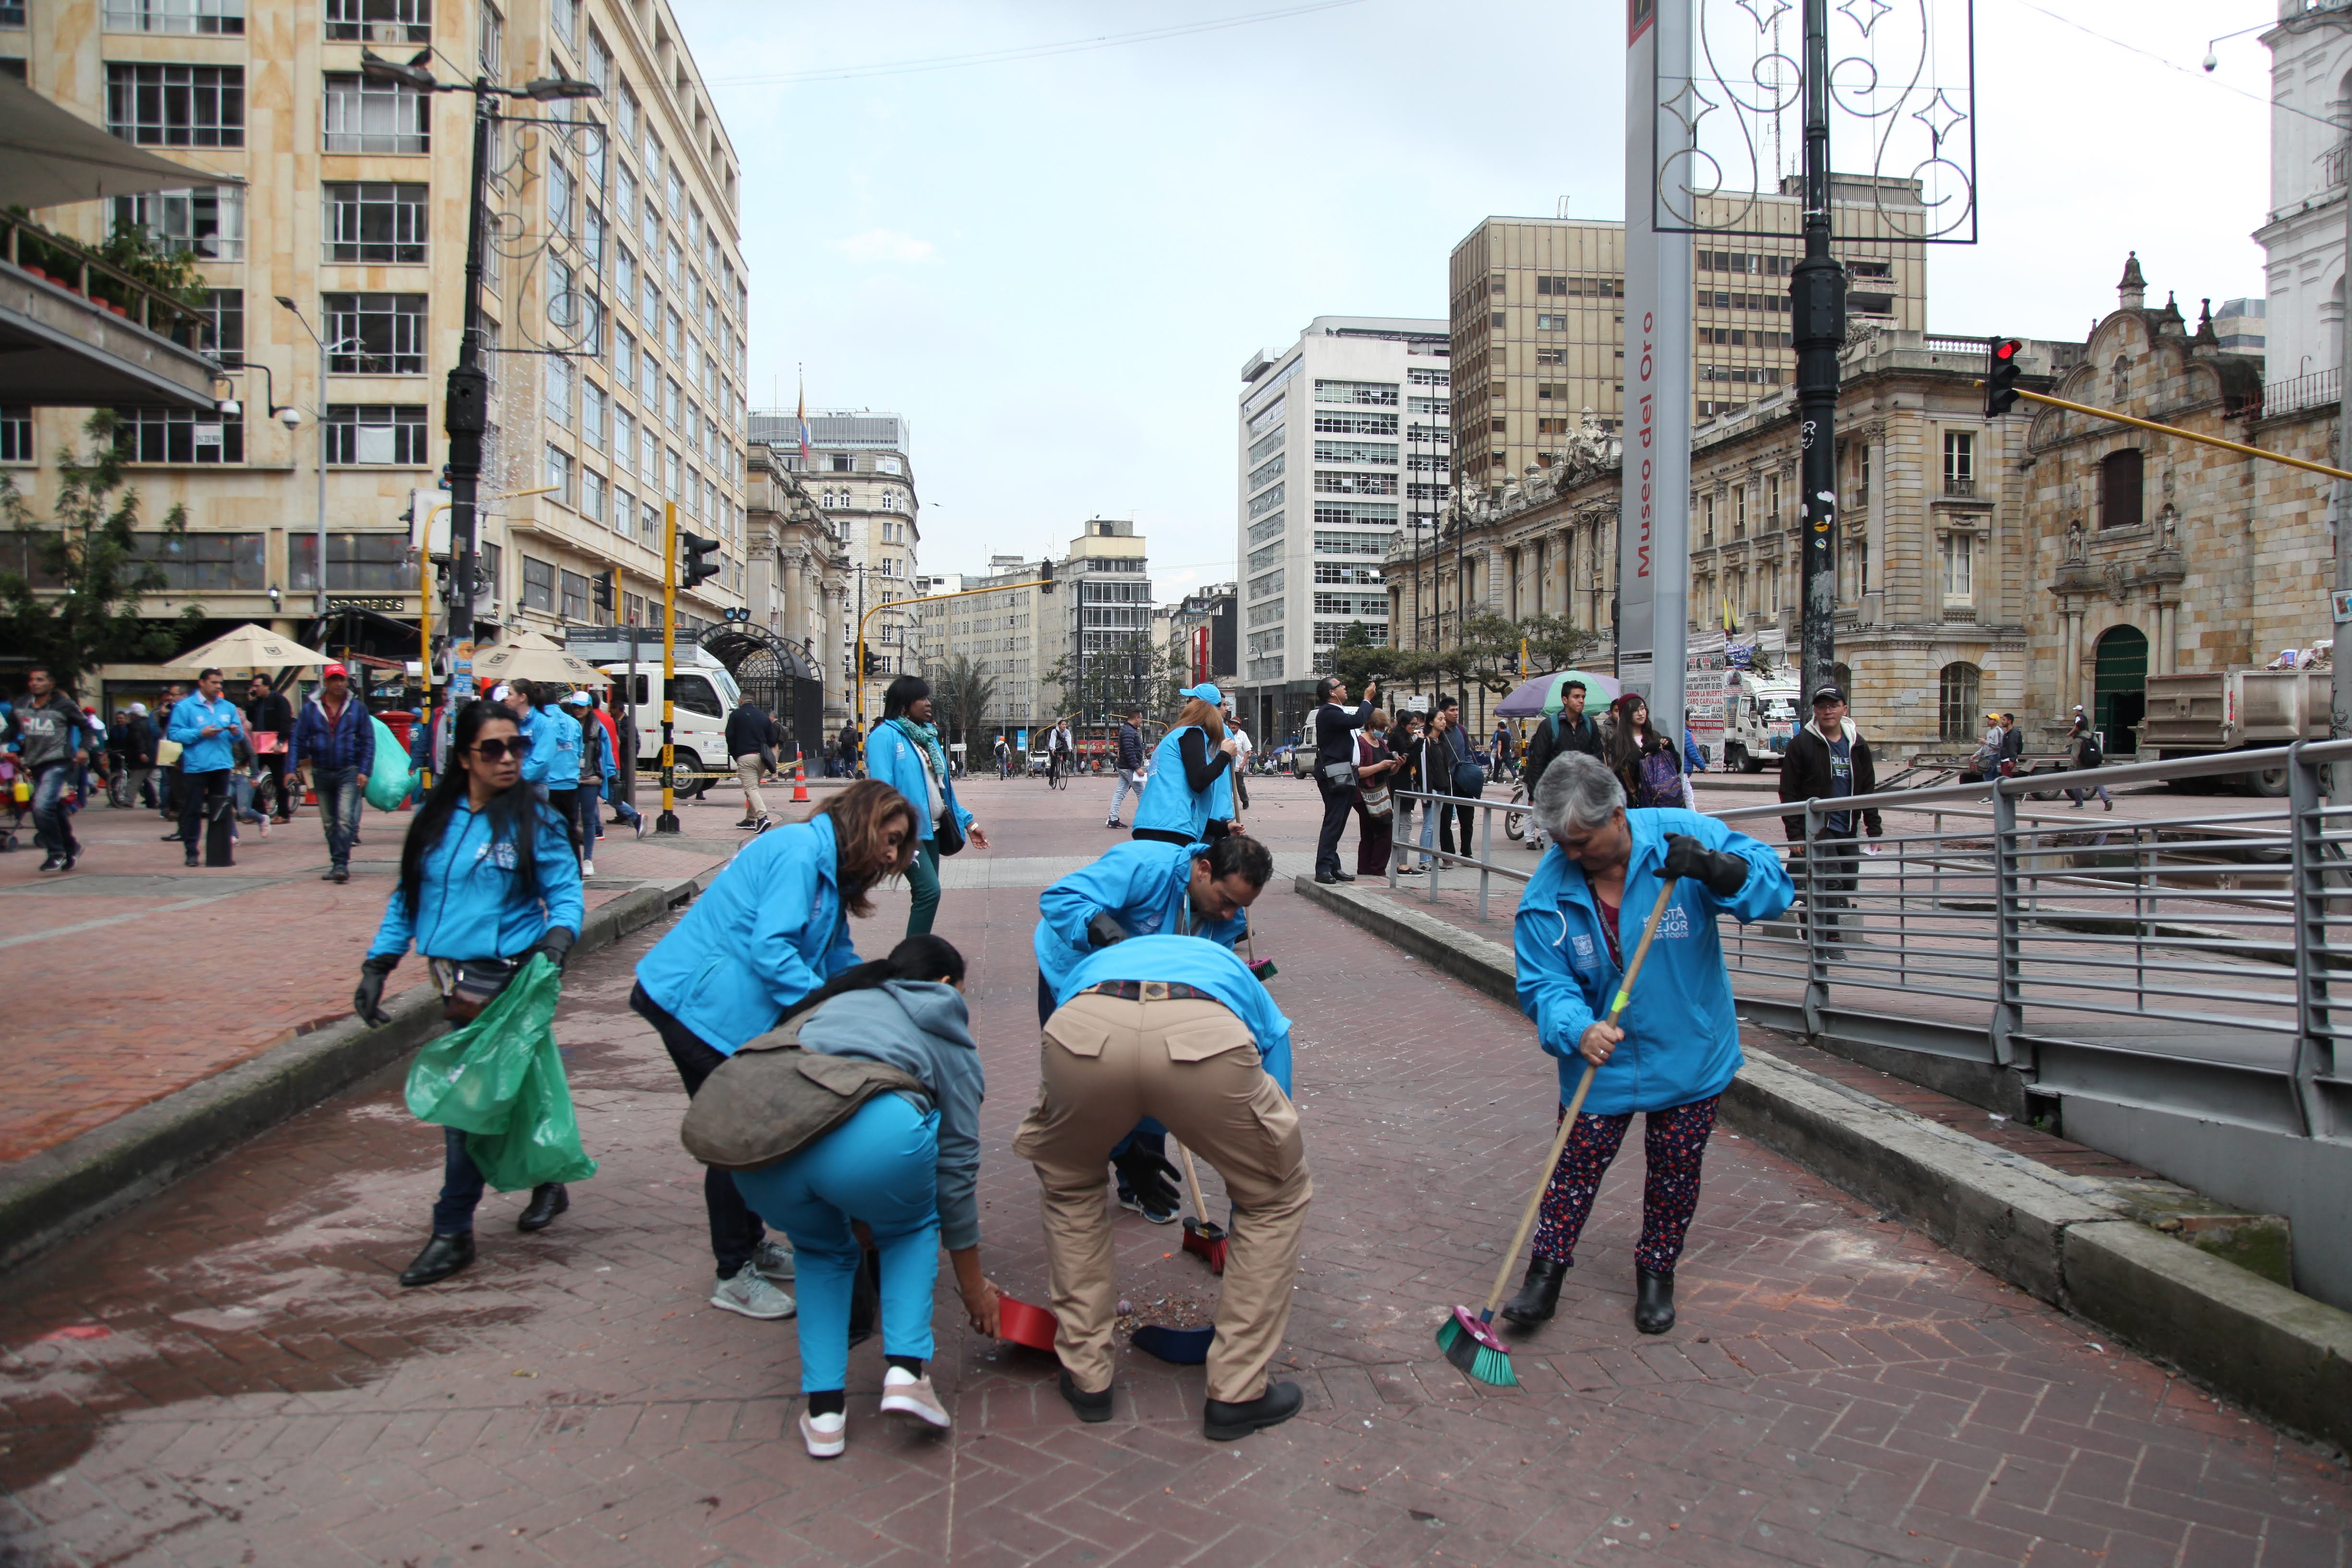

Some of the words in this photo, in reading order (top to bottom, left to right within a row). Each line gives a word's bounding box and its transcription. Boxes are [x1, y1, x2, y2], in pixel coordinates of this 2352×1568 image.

[1640, 311, 1653, 382] Oro
[1639, 393, 1652, 450] del
[1637, 459, 1651, 578] Museo
[327, 598, 404, 609] cDonald's
[1362, 791, 1383, 801] OLOMBIA
[1643, 903, 1686, 923] BOTÁ
[1644, 921, 1688, 933] EJOR
